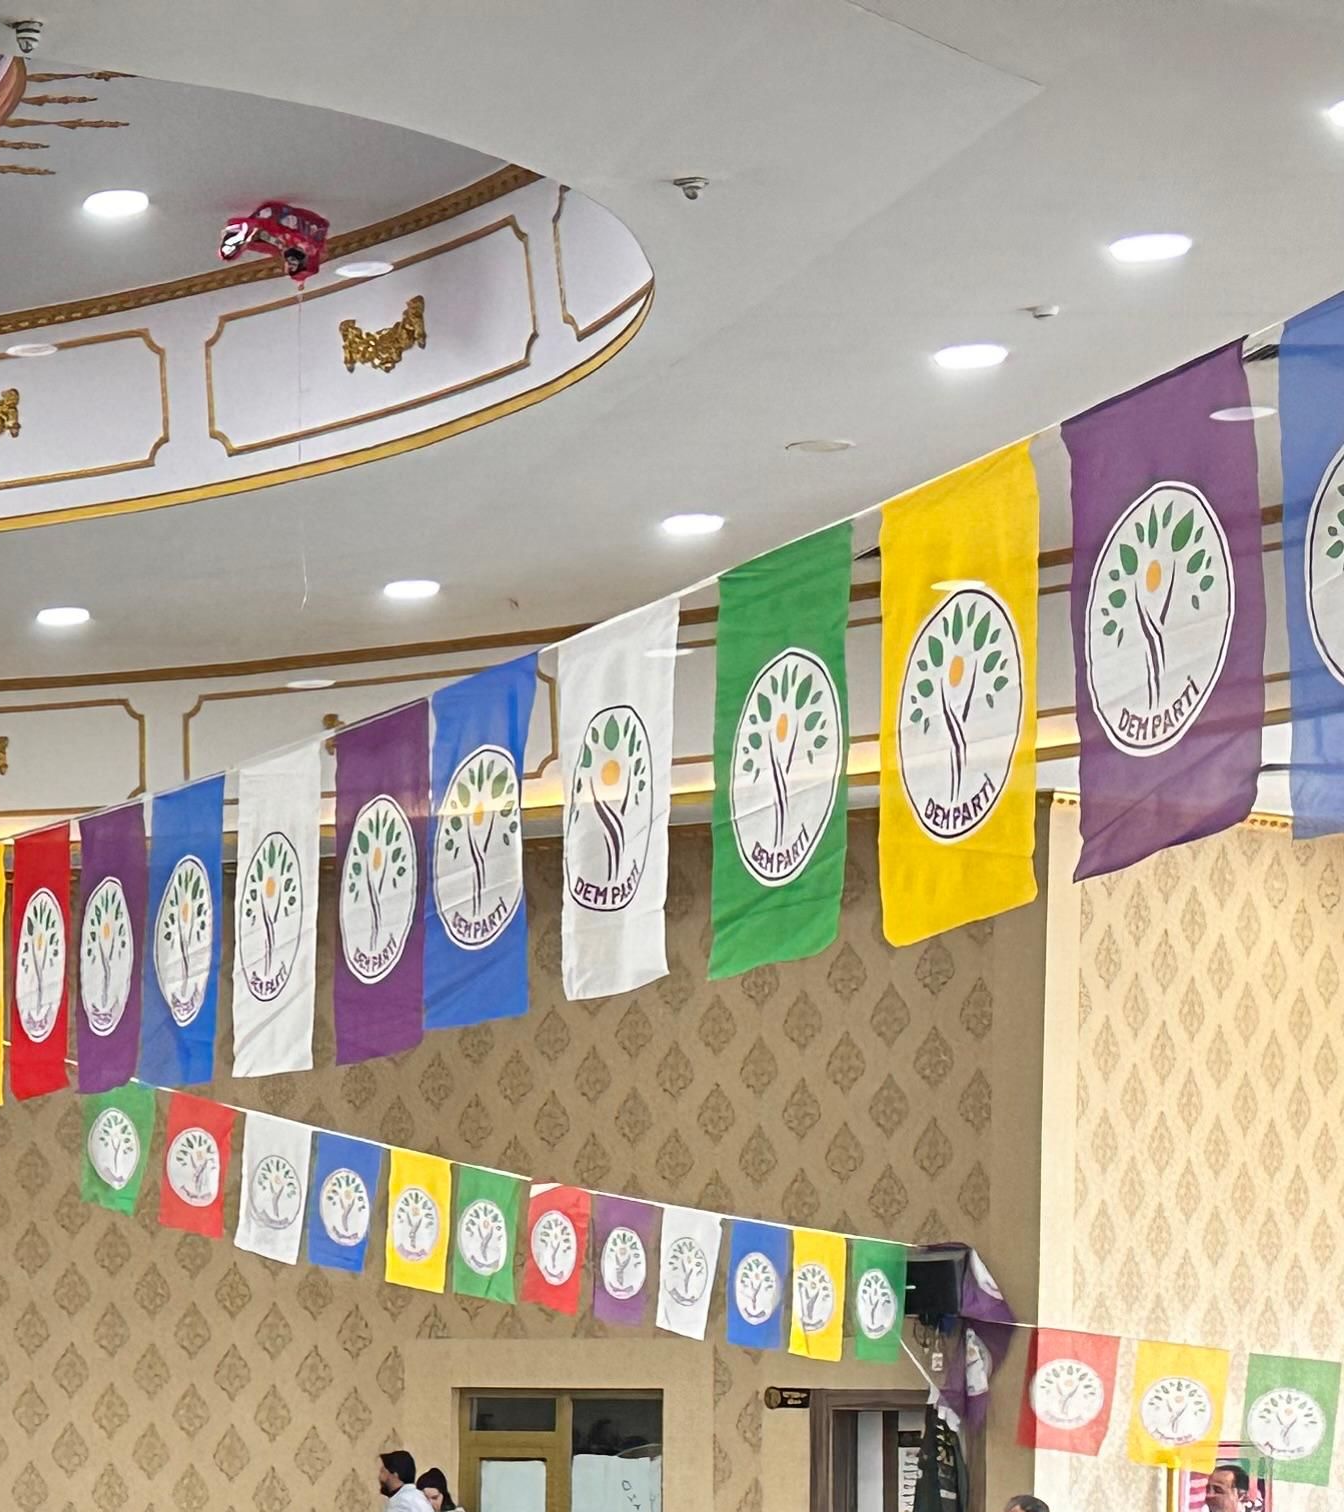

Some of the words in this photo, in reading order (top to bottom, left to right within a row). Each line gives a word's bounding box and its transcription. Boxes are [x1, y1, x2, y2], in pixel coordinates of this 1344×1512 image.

[1118, 707, 1149, 741] DEM
[1151, 674, 1200, 739] PARTİ
[924, 797, 951, 830] DEM
[574, 876, 609, 906] DEM
